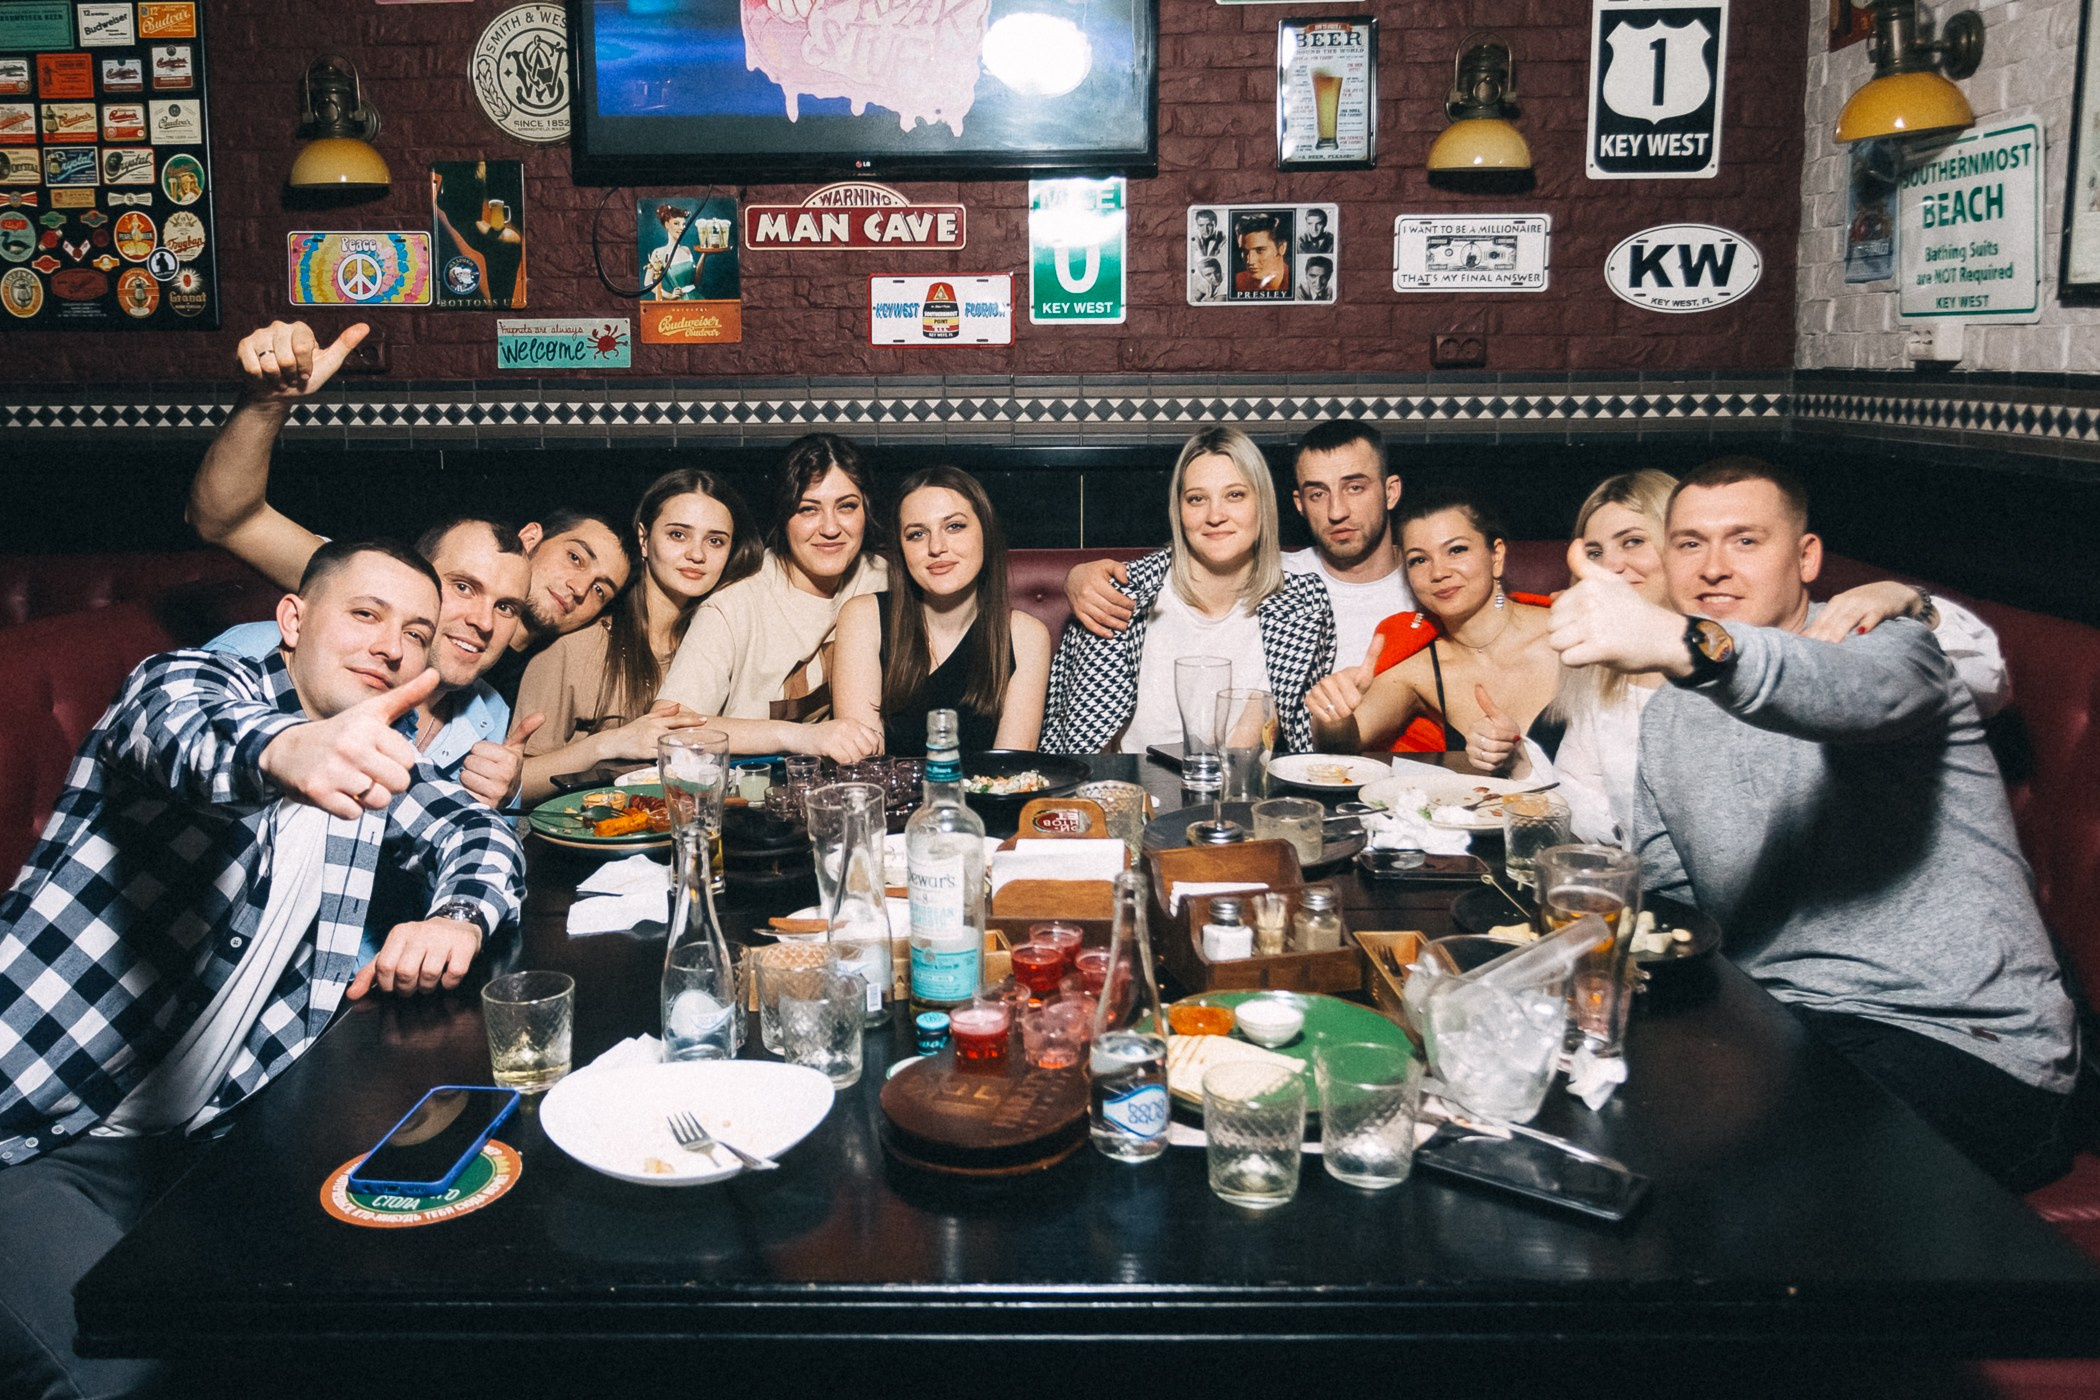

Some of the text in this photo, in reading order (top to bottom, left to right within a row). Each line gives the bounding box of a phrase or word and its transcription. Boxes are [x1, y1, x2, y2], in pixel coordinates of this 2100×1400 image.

[84, 13, 127, 35] Budweiser
[486, 16, 521, 54] SMITH
[525, 12, 534, 23] &
[1649, 38, 1667, 106] 1
[514, 120, 544, 128] SINCE
[1600, 133, 1709, 157] KEY WEST
[1901, 143, 2031, 189] SOUTHERNMOST
[819, 189, 892, 206] WARNING
[1922, 183, 2004, 229] BEACH
[755, 211, 958, 243] MAN CAVE
[1409, 226, 1438, 234] WANT
[1441, 226, 1453, 234] TO
[1456, 225, 1466, 233] BE
[1478, 225, 1542, 233] MILLIONAIRE
[340, 236, 377, 252] Peace
[1925, 240, 1999, 262] Bathing Suits
[1629, 244, 1738, 288] KW
[1916, 261, 2013, 285] are NOT Required
[1461, 274, 1492, 282] FINAL
[1496, 274, 1540, 282] ANSWER
[169, 291, 206, 303] Granat
[1237, 291, 1288, 299] PRESLEY
[1651, 297, 1670, 306] KEY
[1702, 297, 1713, 305] FL
[1936, 295, 1989, 308] KEY WEST
[1042, 302, 1113, 313] KEY WEST
[551, 324, 584, 341] always
[658, 315, 722, 336] Budweiser
